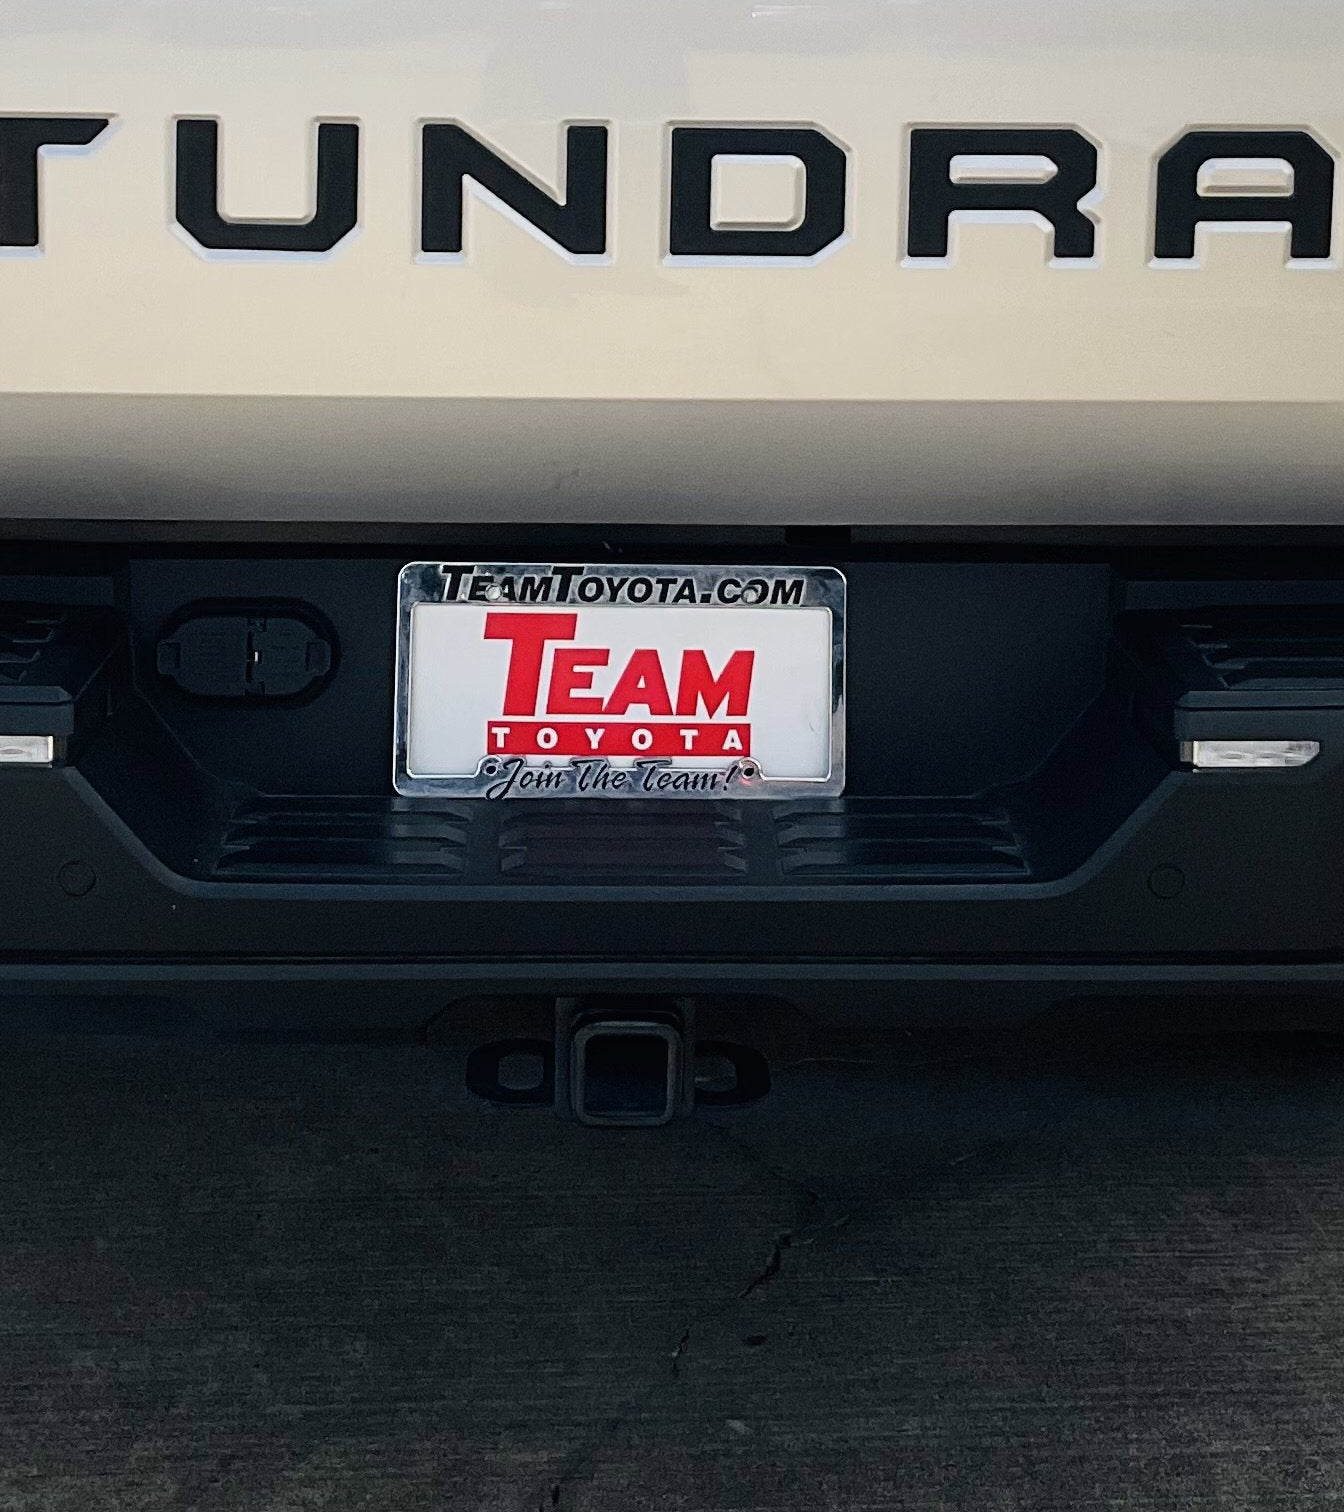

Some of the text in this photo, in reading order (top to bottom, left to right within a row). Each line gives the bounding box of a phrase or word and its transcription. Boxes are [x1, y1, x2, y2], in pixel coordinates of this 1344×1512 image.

[441, 564, 805, 605] TEAMTOYOTA.COM
[484, 612, 755, 719] TEAM
[491, 727, 744, 751] TOYOTA
[485, 757, 739, 800] Join The Team!
